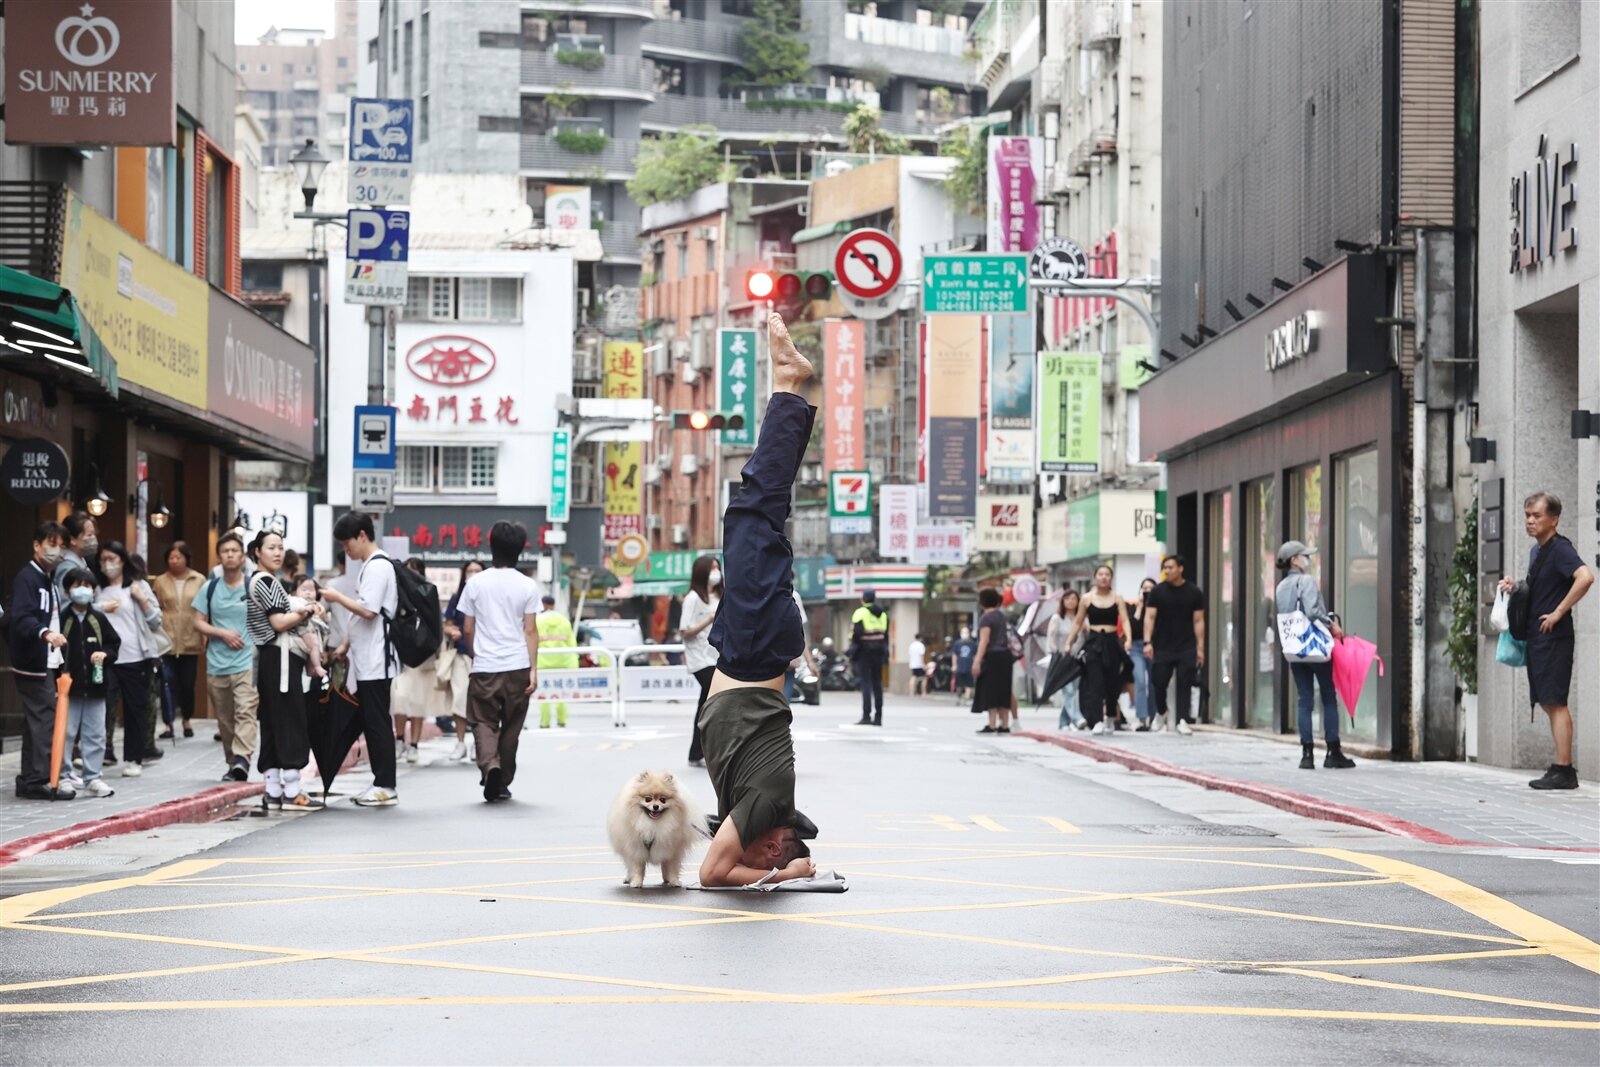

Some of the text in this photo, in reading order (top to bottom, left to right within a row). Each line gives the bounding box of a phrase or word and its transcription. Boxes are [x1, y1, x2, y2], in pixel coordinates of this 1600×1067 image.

[19, 69, 157, 94] SUNMERRY
[50, 96, 127, 117] 聖瑪莉
[348, 211, 386, 257] P
[934, 261, 1017, 276] 信義路二段
[1004, 280, 1011, 289] 2
[24, 468, 48, 478] TAX
[10, 479, 61, 489] REFUND
[359, 486, 387, 496] MRT
